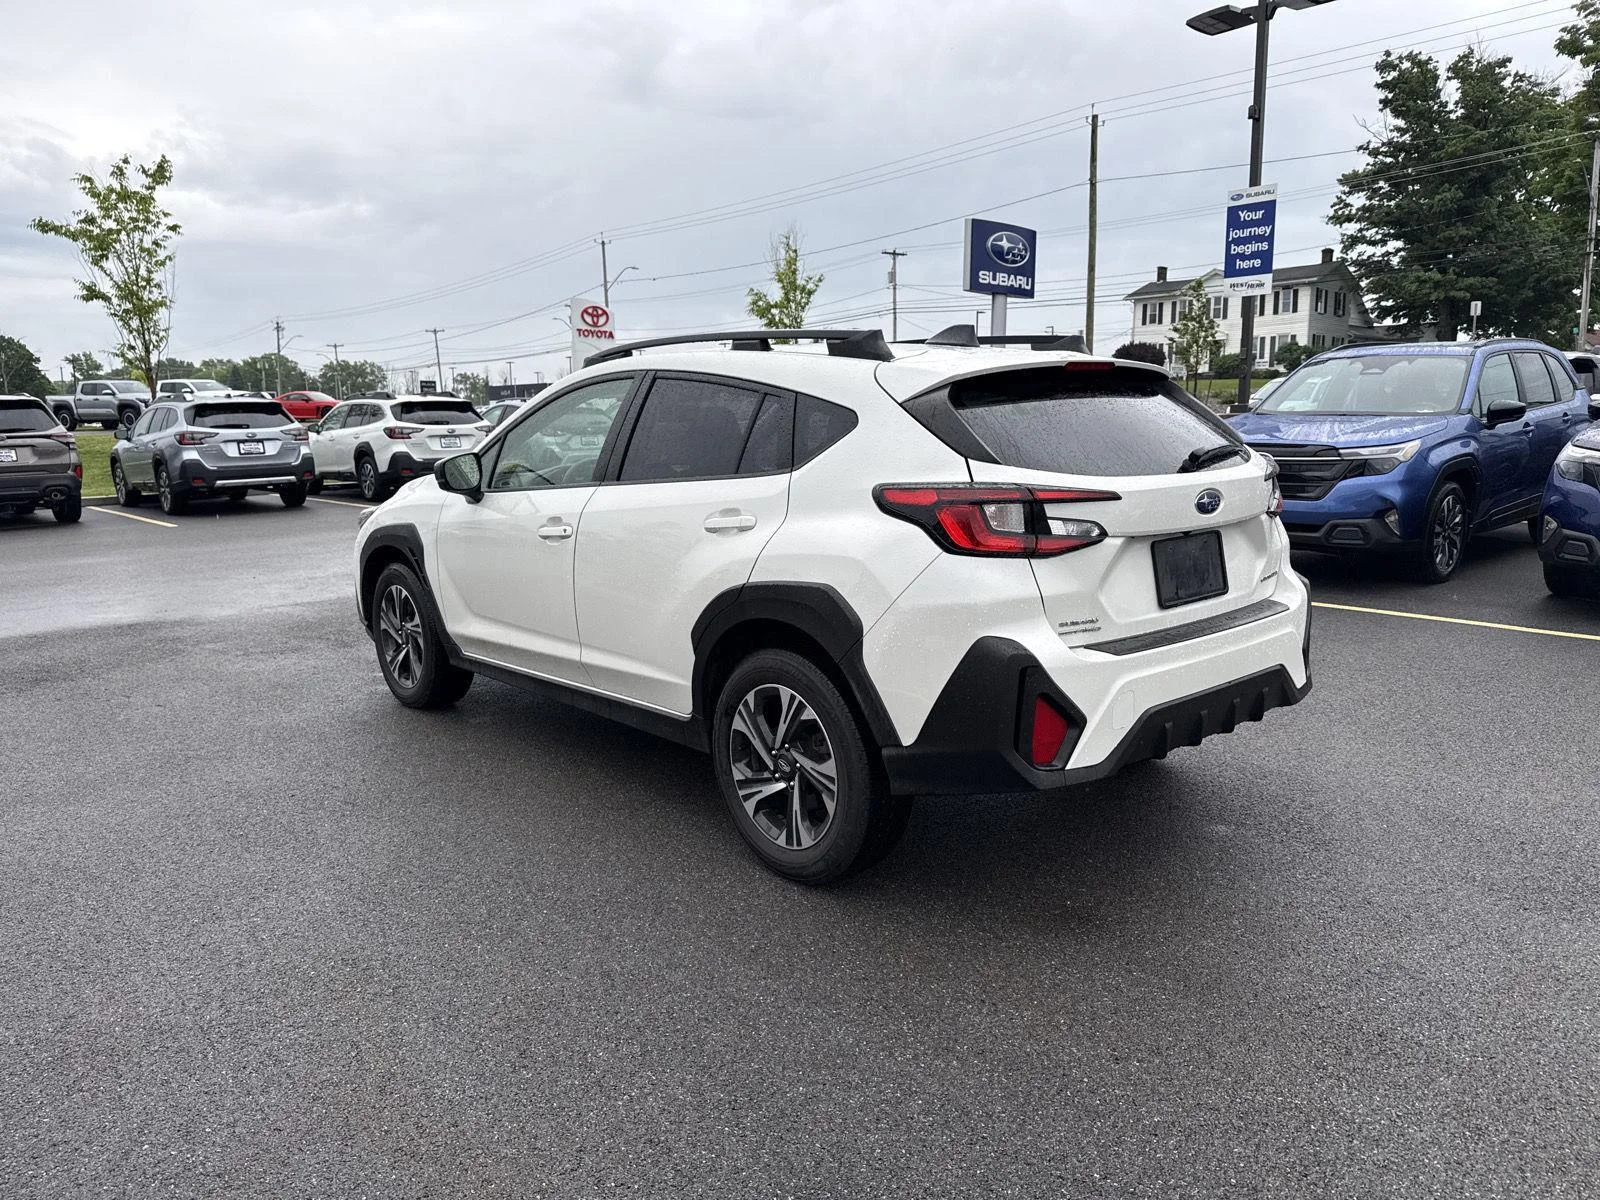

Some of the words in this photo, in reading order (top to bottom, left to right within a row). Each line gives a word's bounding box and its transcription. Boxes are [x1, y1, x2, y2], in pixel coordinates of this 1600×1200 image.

[1245, 189, 1275, 199] SUBARU
[1238, 209, 1265, 222] Your
[1228, 225, 1273, 241] journey
[1230, 241, 1269, 255] begins
[1235, 258, 1261, 270] here
[978, 270, 1032, 290] SUBARU
[576, 328, 615, 340] TOYOTA
